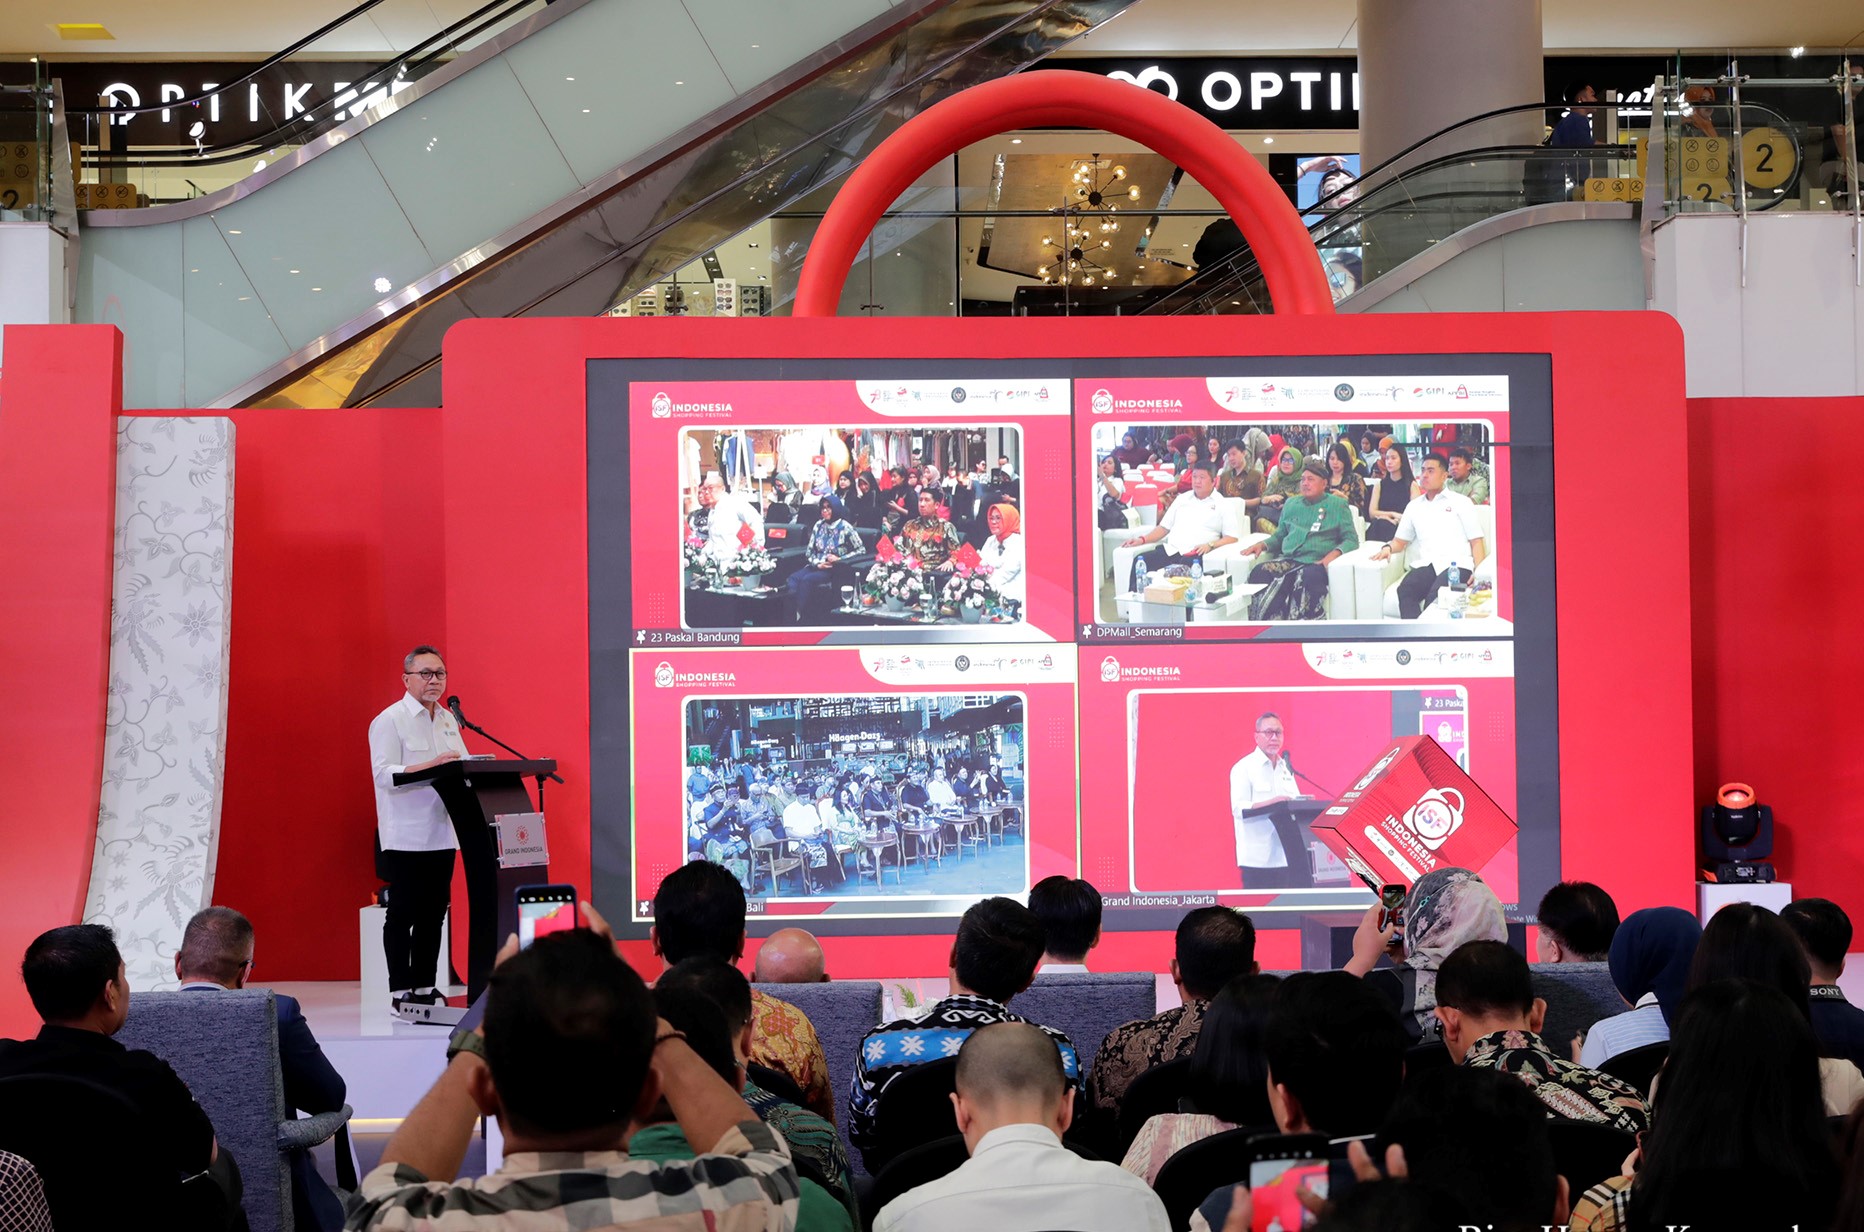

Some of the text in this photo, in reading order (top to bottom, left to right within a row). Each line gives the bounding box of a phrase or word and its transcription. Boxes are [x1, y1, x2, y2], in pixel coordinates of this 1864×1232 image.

[1756, 144, 1773, 172] 2
[2, 189, 19, 210] 2
[672, 403, 733, 412] INDONESIA
[1115, 399, 1183, 408] INDONESIA
[651, 632, 740, 644] 23 Paskal Bandung
[1097, 627, 1182, 638] DPMall_Semarang
[675, 672, 736, 681] INDONESIA
[1121, 667, 1181, 676] INDONESIA
[1435, 699, 1443, 707] 23
[1417, 804, 1448, 829] ISF
[1385, 814, 1437, 868] INDONESIA
[1381, 821, 1407, 848] SHOPPING
[1407, 847, 1430, 873] FESTIVAL
[1101, 895, 1215, 907] Grand Indonesia_Jakarta
[1810, 987, 1839, 996] SONY
